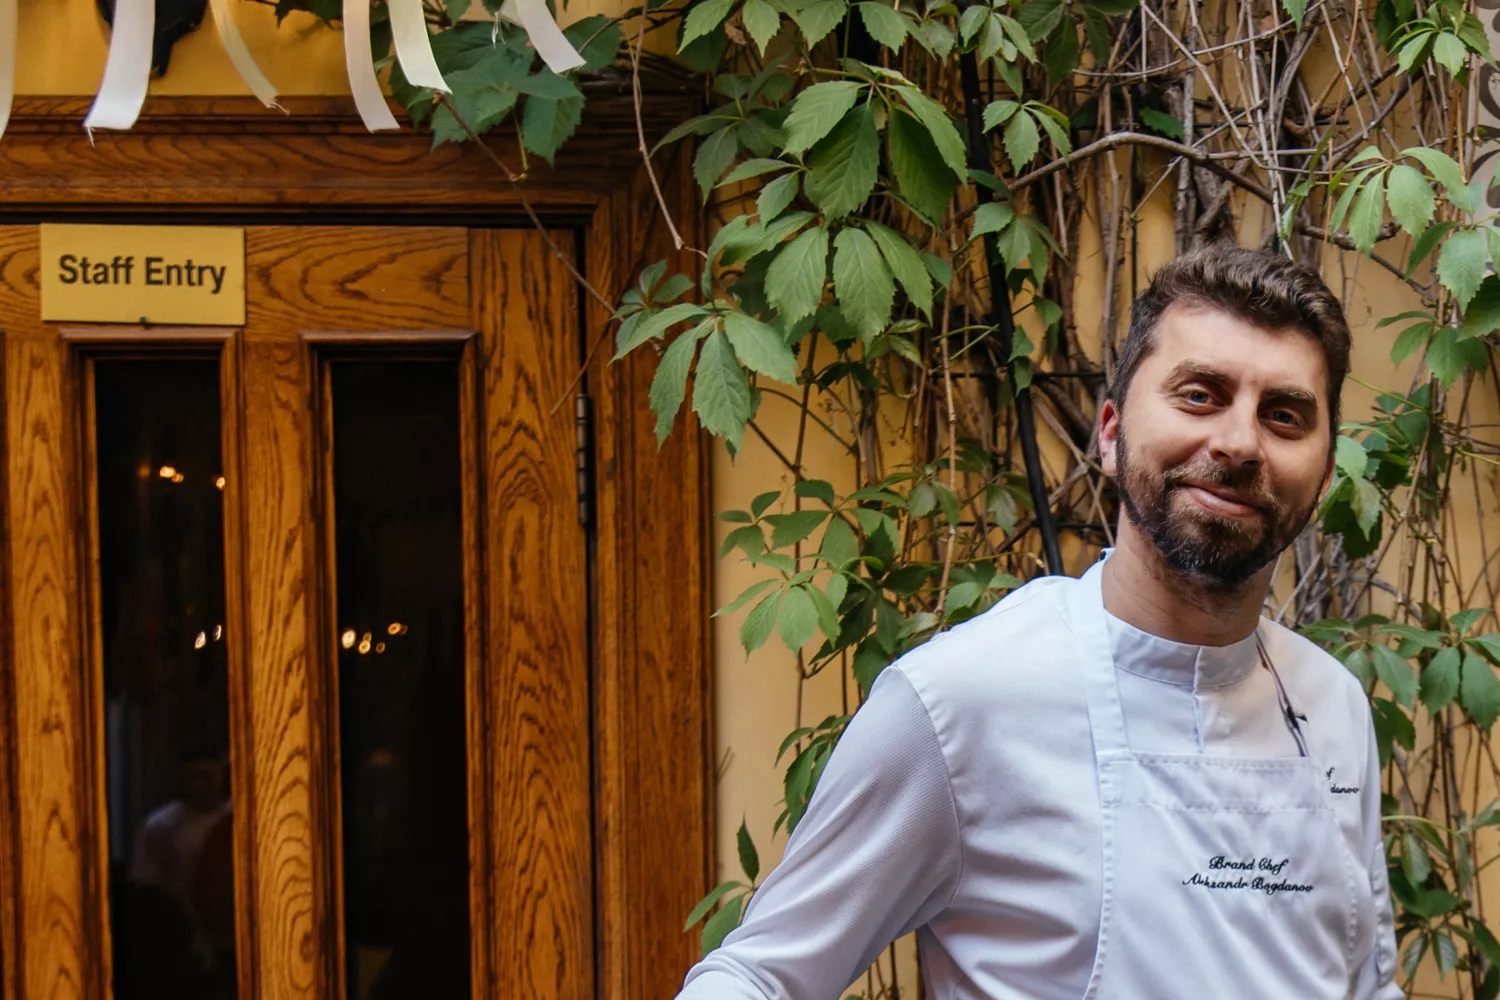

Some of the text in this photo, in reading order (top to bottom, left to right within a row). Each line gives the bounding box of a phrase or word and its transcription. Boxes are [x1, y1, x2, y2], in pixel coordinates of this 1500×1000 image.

[58, 254, 227, 295] Staff Entry
[1208, 856, 1290, 876] Brand Chef
